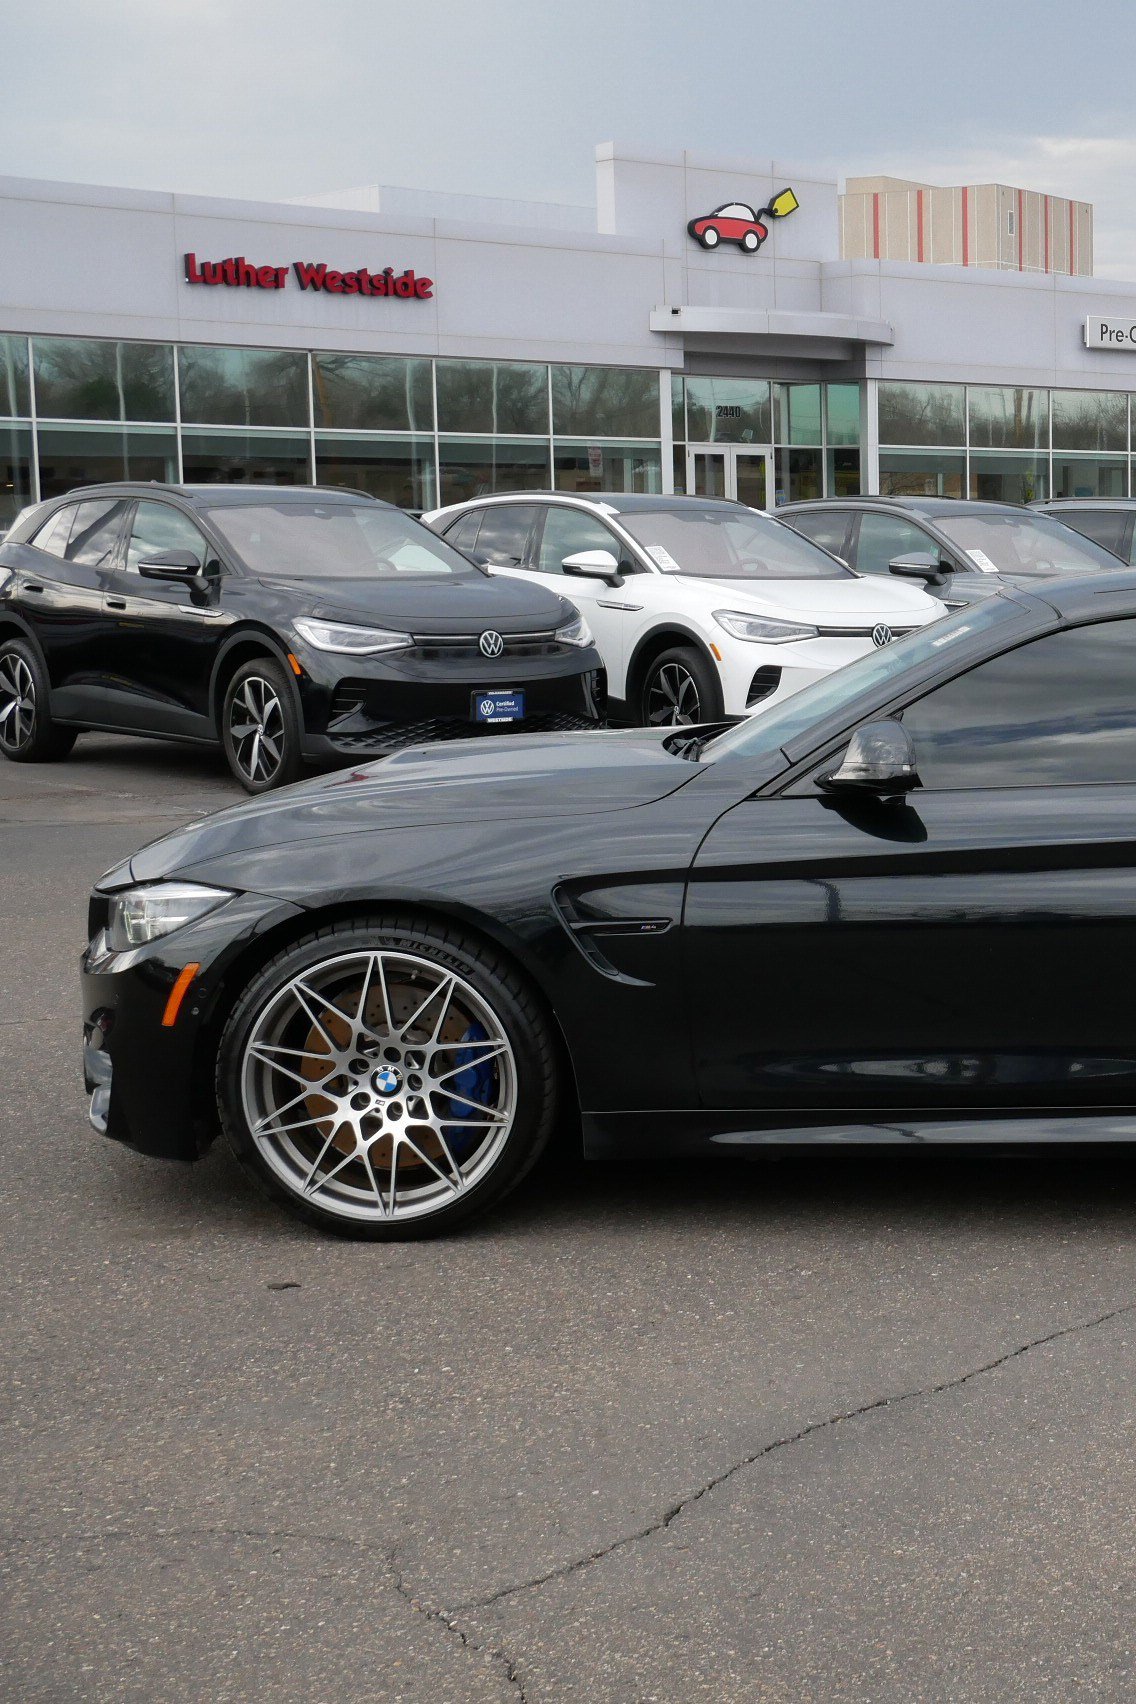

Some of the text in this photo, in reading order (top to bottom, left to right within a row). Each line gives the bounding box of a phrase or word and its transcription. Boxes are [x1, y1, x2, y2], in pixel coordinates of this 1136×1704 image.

[184, 252, 433, 300] Luther Westside
[716, 405, 741, 418] 2440
